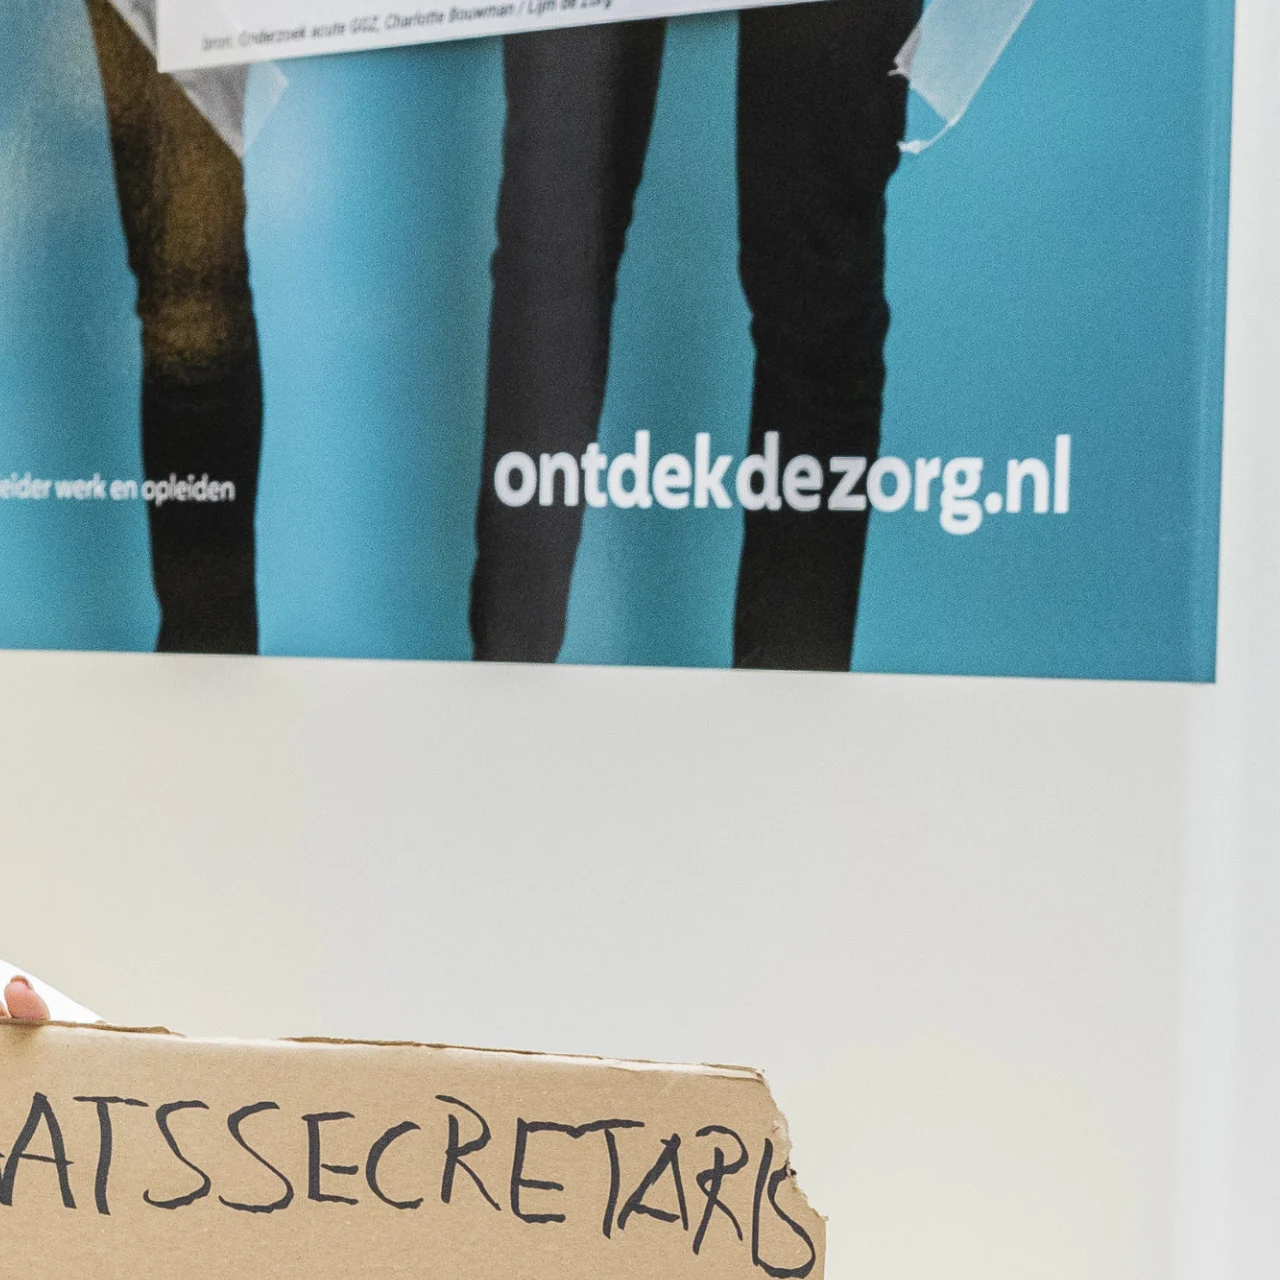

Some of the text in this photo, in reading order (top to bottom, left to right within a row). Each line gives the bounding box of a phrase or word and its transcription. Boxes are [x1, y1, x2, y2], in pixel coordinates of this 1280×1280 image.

[54, 473, 107, 500] werk
[110, 478, 138, 500] en
[142, 472, 236, 507] opleiden
[493, 430, 1071, 535] ontdekdezorg.nl
